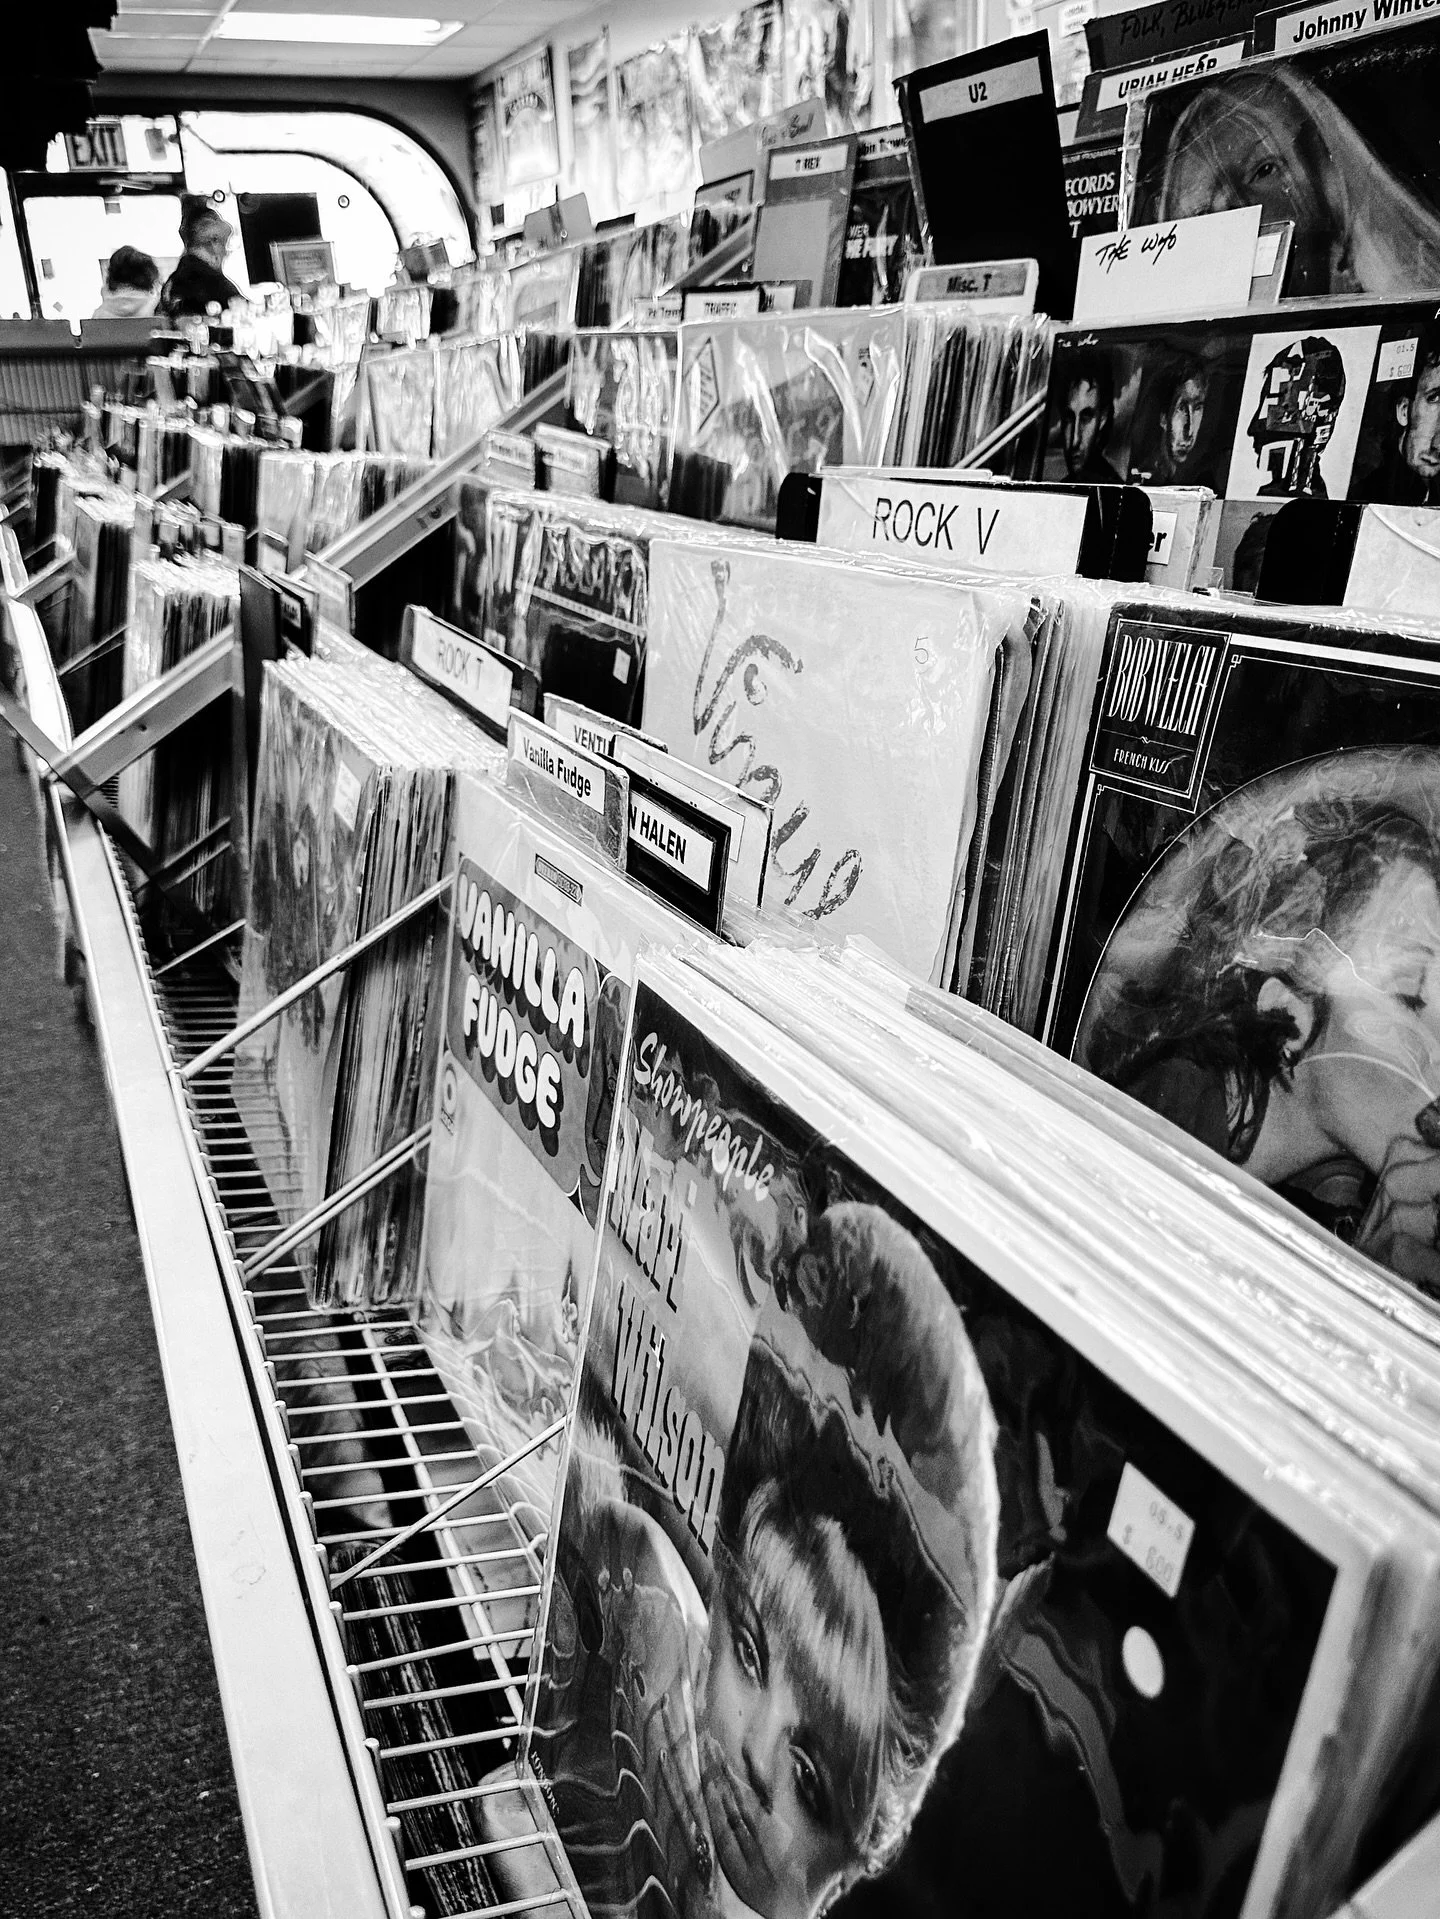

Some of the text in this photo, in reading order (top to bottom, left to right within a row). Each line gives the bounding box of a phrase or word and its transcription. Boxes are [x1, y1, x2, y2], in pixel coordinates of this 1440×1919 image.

[1293, 0, 1440, 43] Johnny Winte
[968, 81, 988, 104] U2
[71, 126, 126, 167] EXIT
[982, 273, 992, 293] T
[1095, 234, 1132, 274] THE
[872, 496, 1001, 555] ROCK V
[438, 638, 484, 692] ROCK T
[1106, 633, 1218, 737] BOB WELCH
[523, 736, 592, 798] Vanilla Fudge
[1113, 748, 1147, 770] FRENCH
[639, 808, 687, 866] HALEN
[457, 872, 587, 1049] VANILLA
[463, 972, 562, 1129] FUDGE
[632, 1031, 776, 1202] Showpeople
[611, 1278, 726, 1557] Wilson
